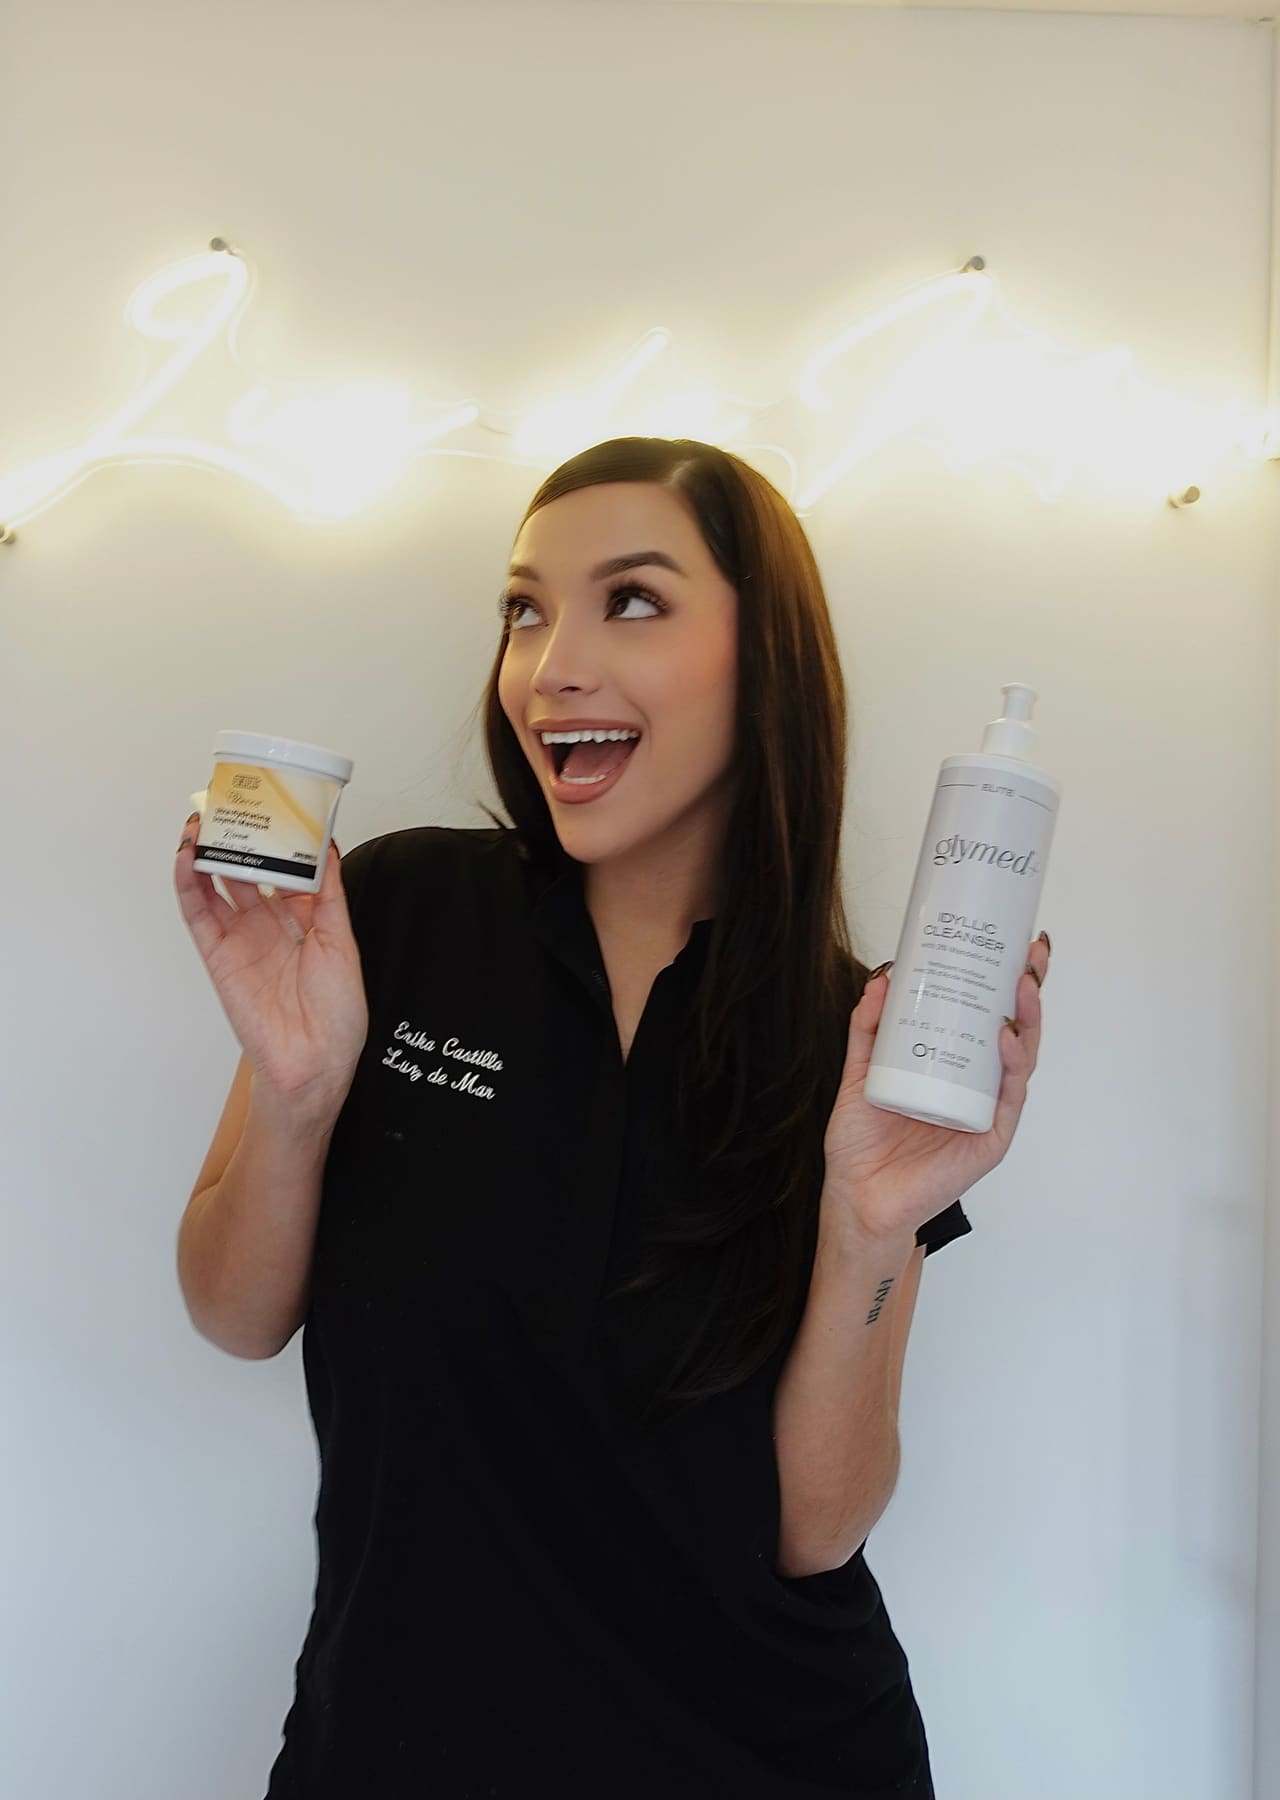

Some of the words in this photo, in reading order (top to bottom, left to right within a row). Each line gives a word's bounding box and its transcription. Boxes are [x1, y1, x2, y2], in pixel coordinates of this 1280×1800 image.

[981, 783, 1016, 797] ELITE
[937, 912, 998, 935] IDYLLIC
[923, 924, 1006, 953] CLEANSER
[394, 1021, 436, 1051] Erika
[442, 1037, 504, 1071] Castillo
[912, 1043, 936, 1061] 01
[382, 1047, 423, 1082] Luz
[427, 1066, 448, 1085] de
[450, 1071, 496, 1100] Mar
